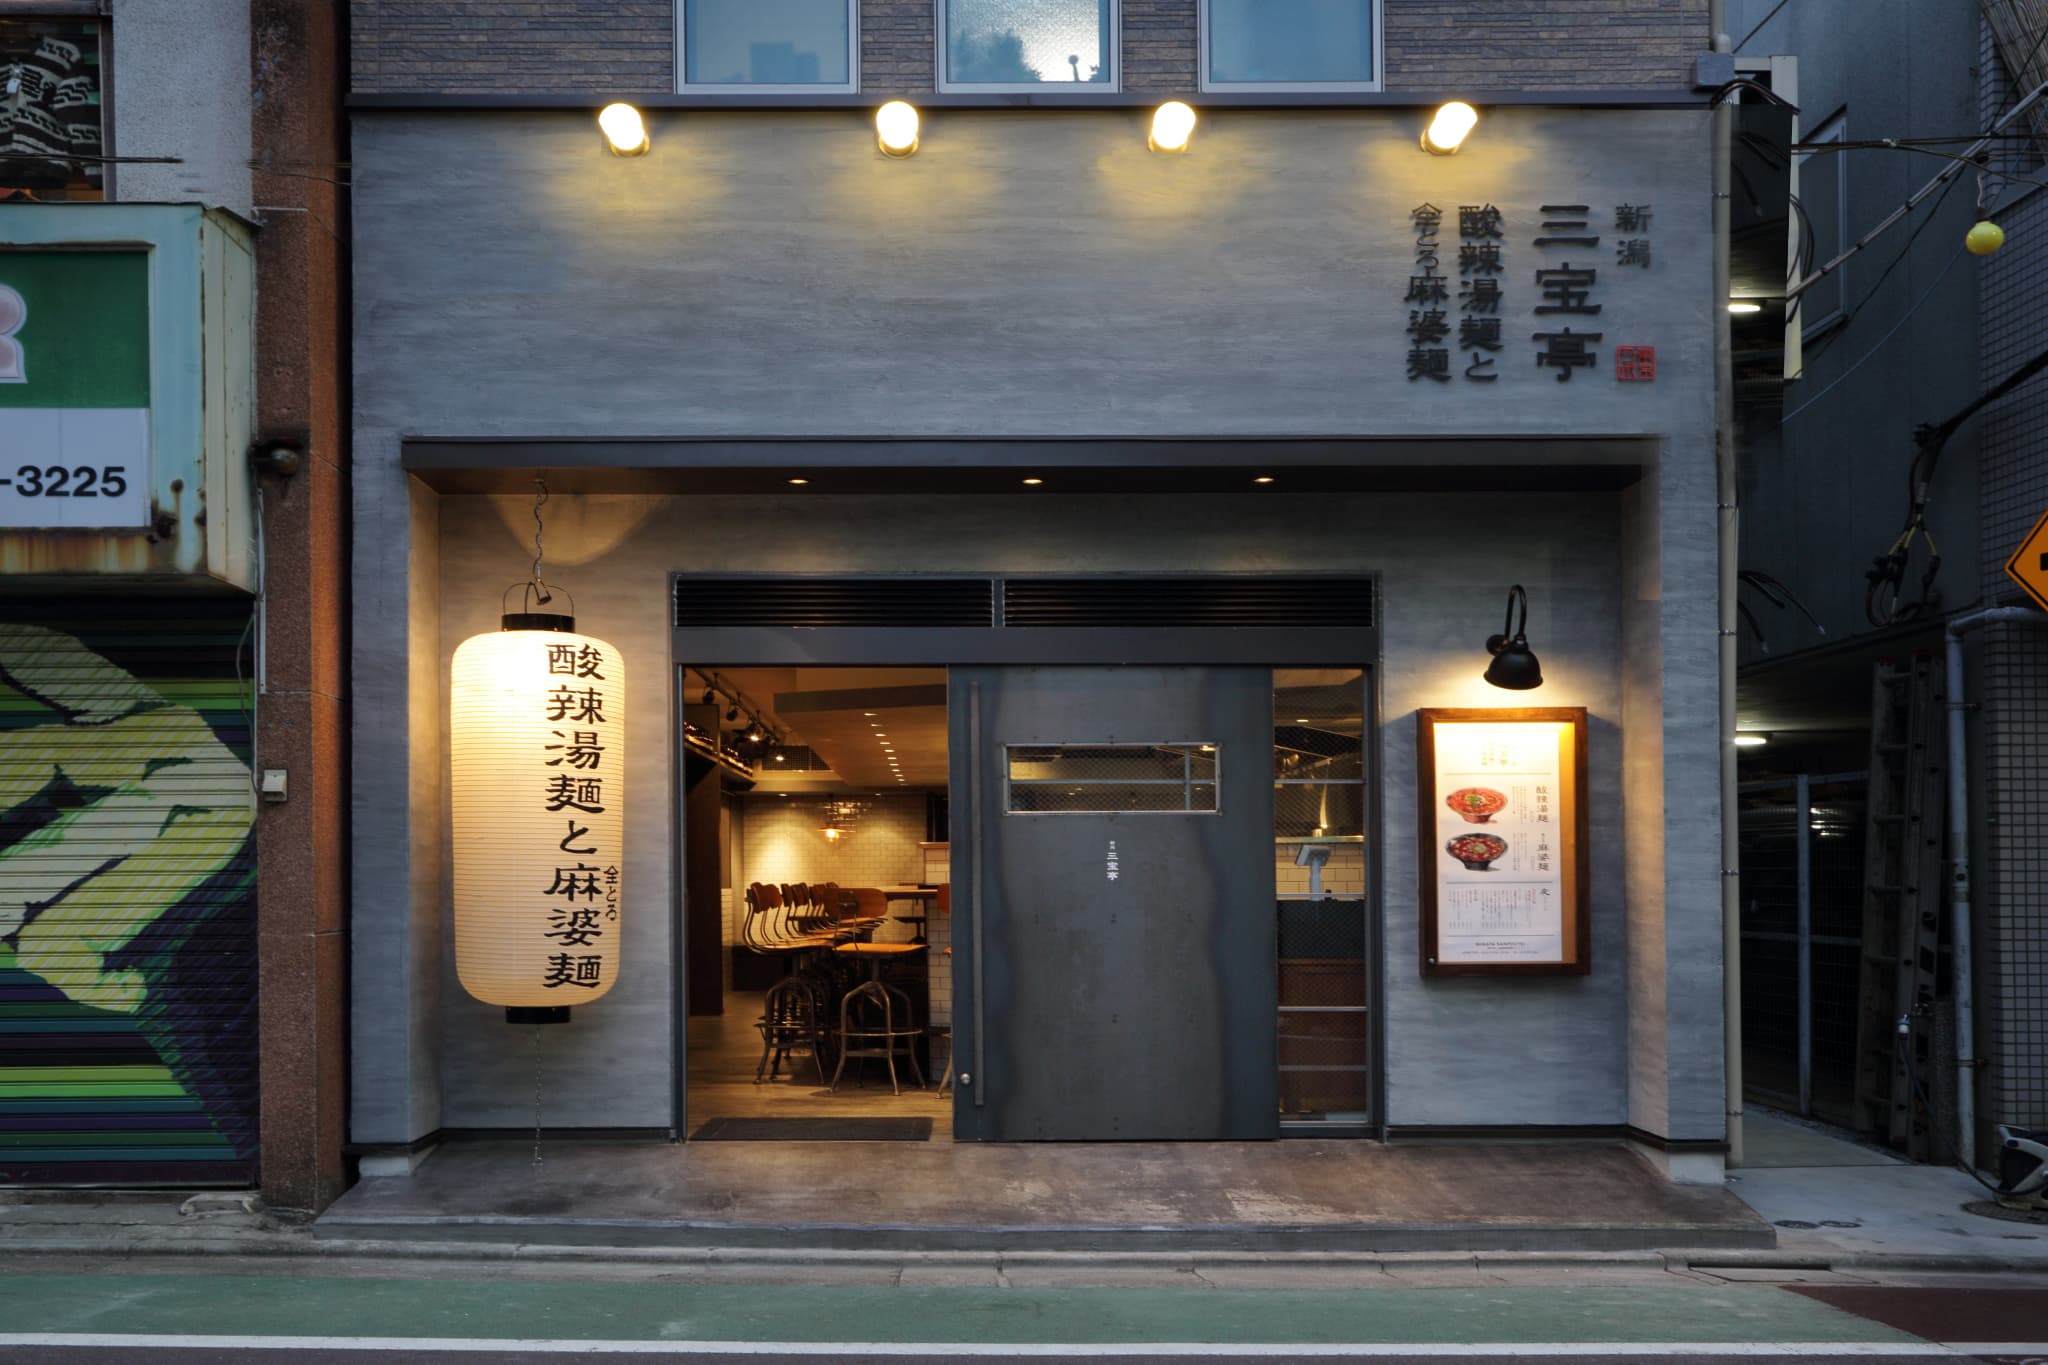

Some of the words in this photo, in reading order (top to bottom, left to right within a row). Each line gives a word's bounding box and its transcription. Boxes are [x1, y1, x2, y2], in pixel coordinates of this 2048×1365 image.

[1458, 203, 1503, 381] 酸辣湯麺と
[1532, 205, 1602, 382] 三宝亭
[1615, 203, 1653, 269] 新潟
[543, 643, 606, 989] 酸辣湯麺と麻婆麺
